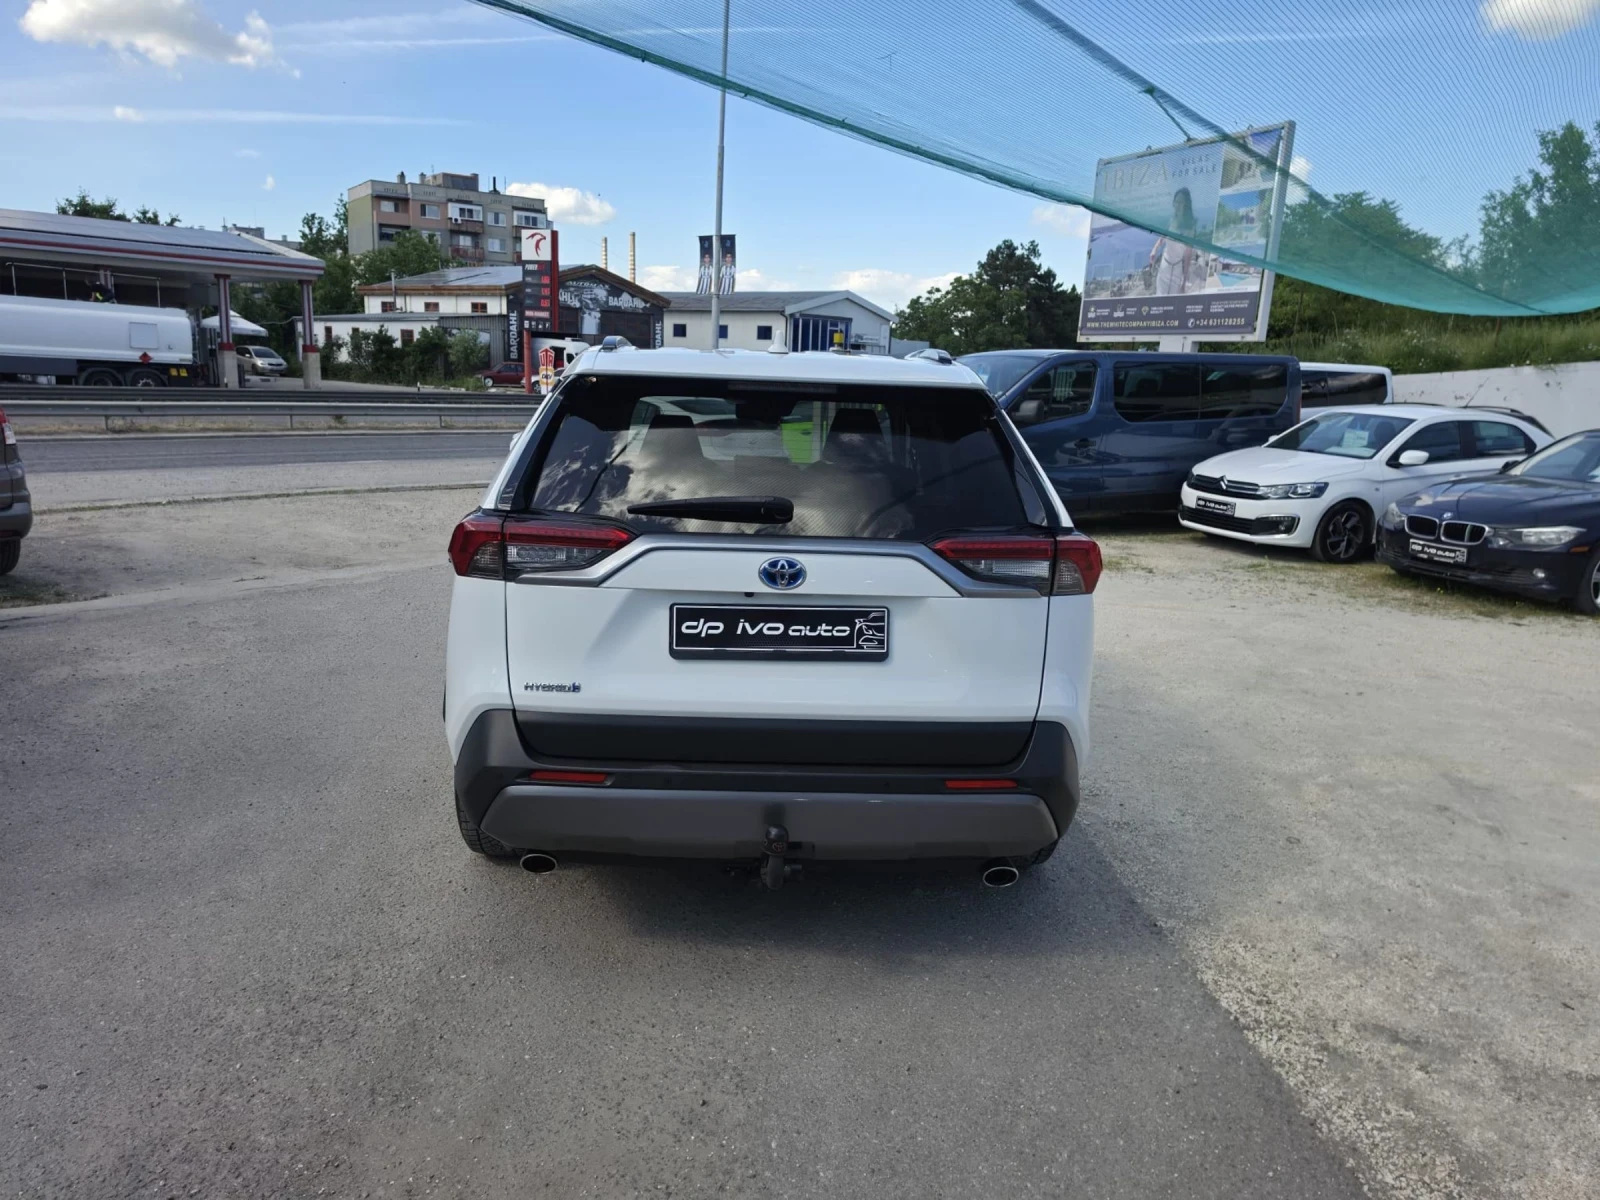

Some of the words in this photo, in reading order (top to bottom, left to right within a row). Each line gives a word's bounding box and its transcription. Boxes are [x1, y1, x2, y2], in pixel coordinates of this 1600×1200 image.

[1103, 161, 1168, 192] IBIZA
[509, 310, 519, 359] BARDAHL
[681, 618, 725, 637] dp
[736, 619, 785, 635] ivo
[788, 623, 850, 637] auto
[523, 682, 572, 693] HYBRID
